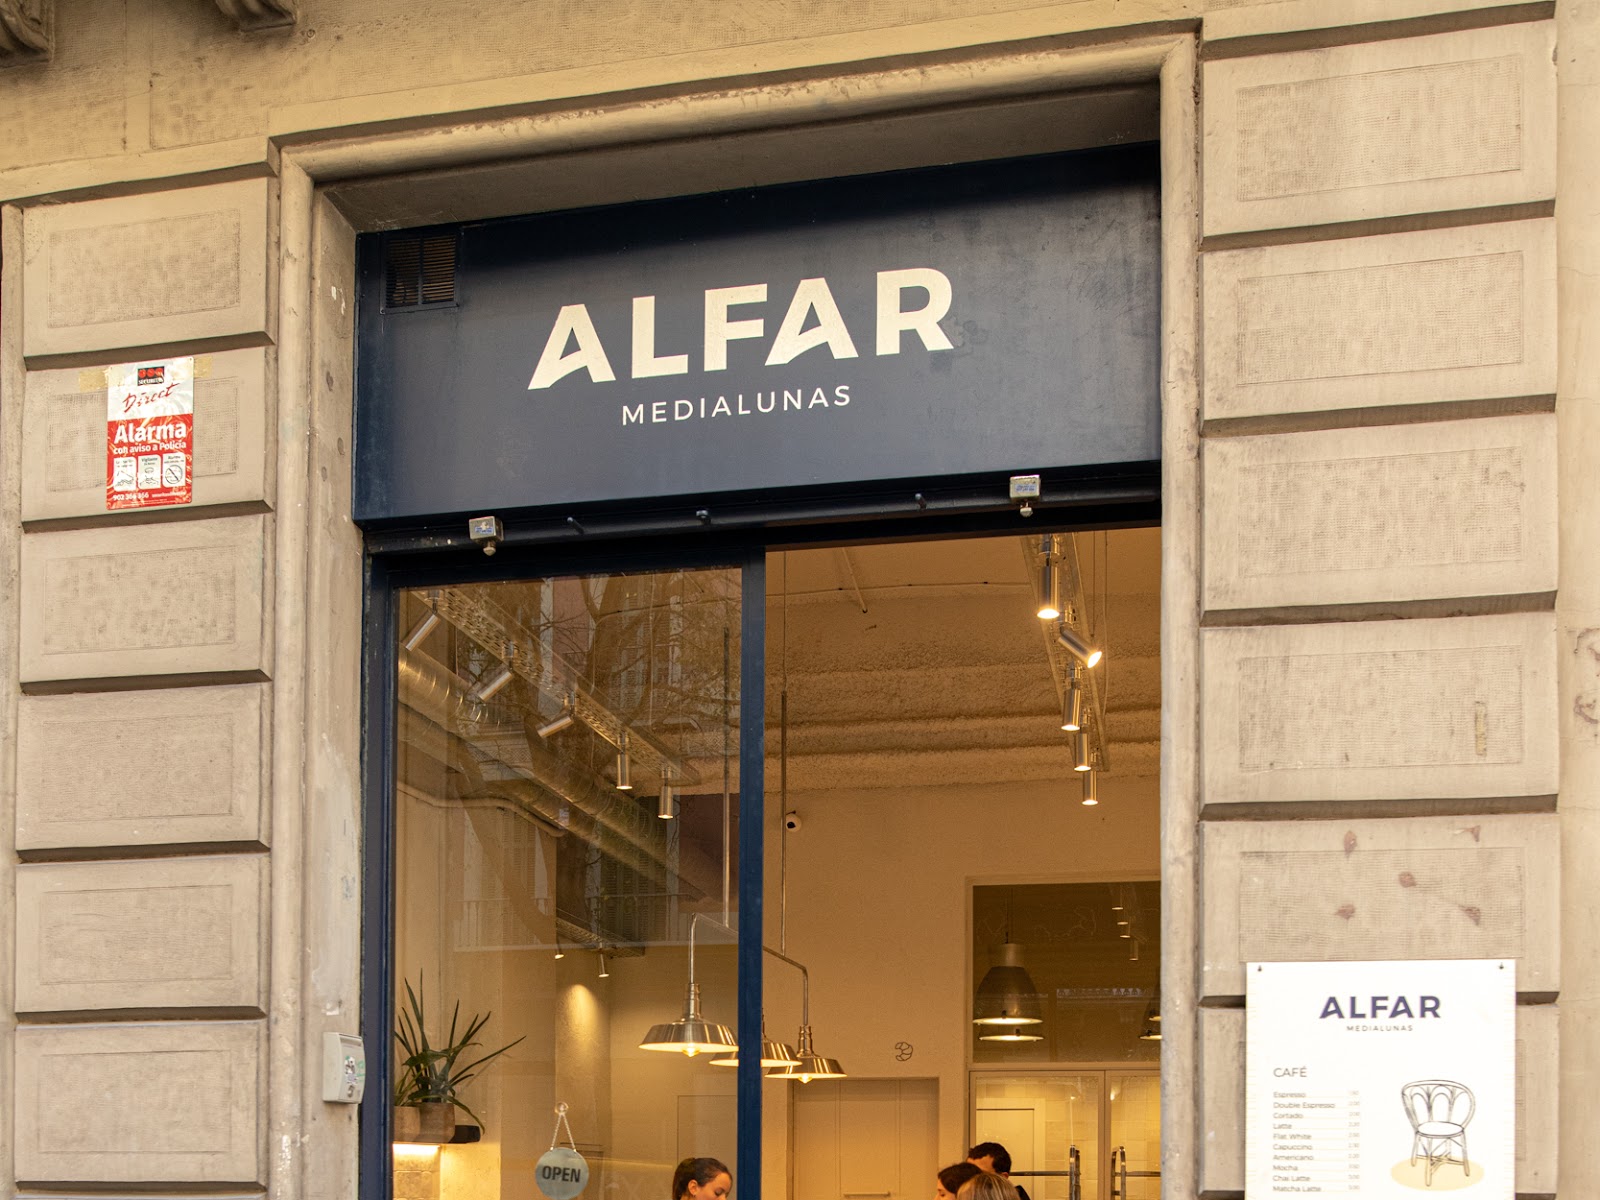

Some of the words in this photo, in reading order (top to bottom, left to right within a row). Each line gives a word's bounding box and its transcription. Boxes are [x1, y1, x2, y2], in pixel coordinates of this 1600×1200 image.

[527, 267, 954, 390] ALFAR
[122, 382, 180, 412] Direct
[621, 385, 852, 426] MEDIALUNAS
[114, 423, 186, 444] Alarma
[114, 446, 128, 454] con
[130, 443, 150, 452] aviso
[160, 440, 186, 450] Policía
[1319, 996, 1441, 1020] ALFAR
[1272, 1066, 1308, 1078] CAFÉ
[542, 1165, 581, 1183] OPEN
